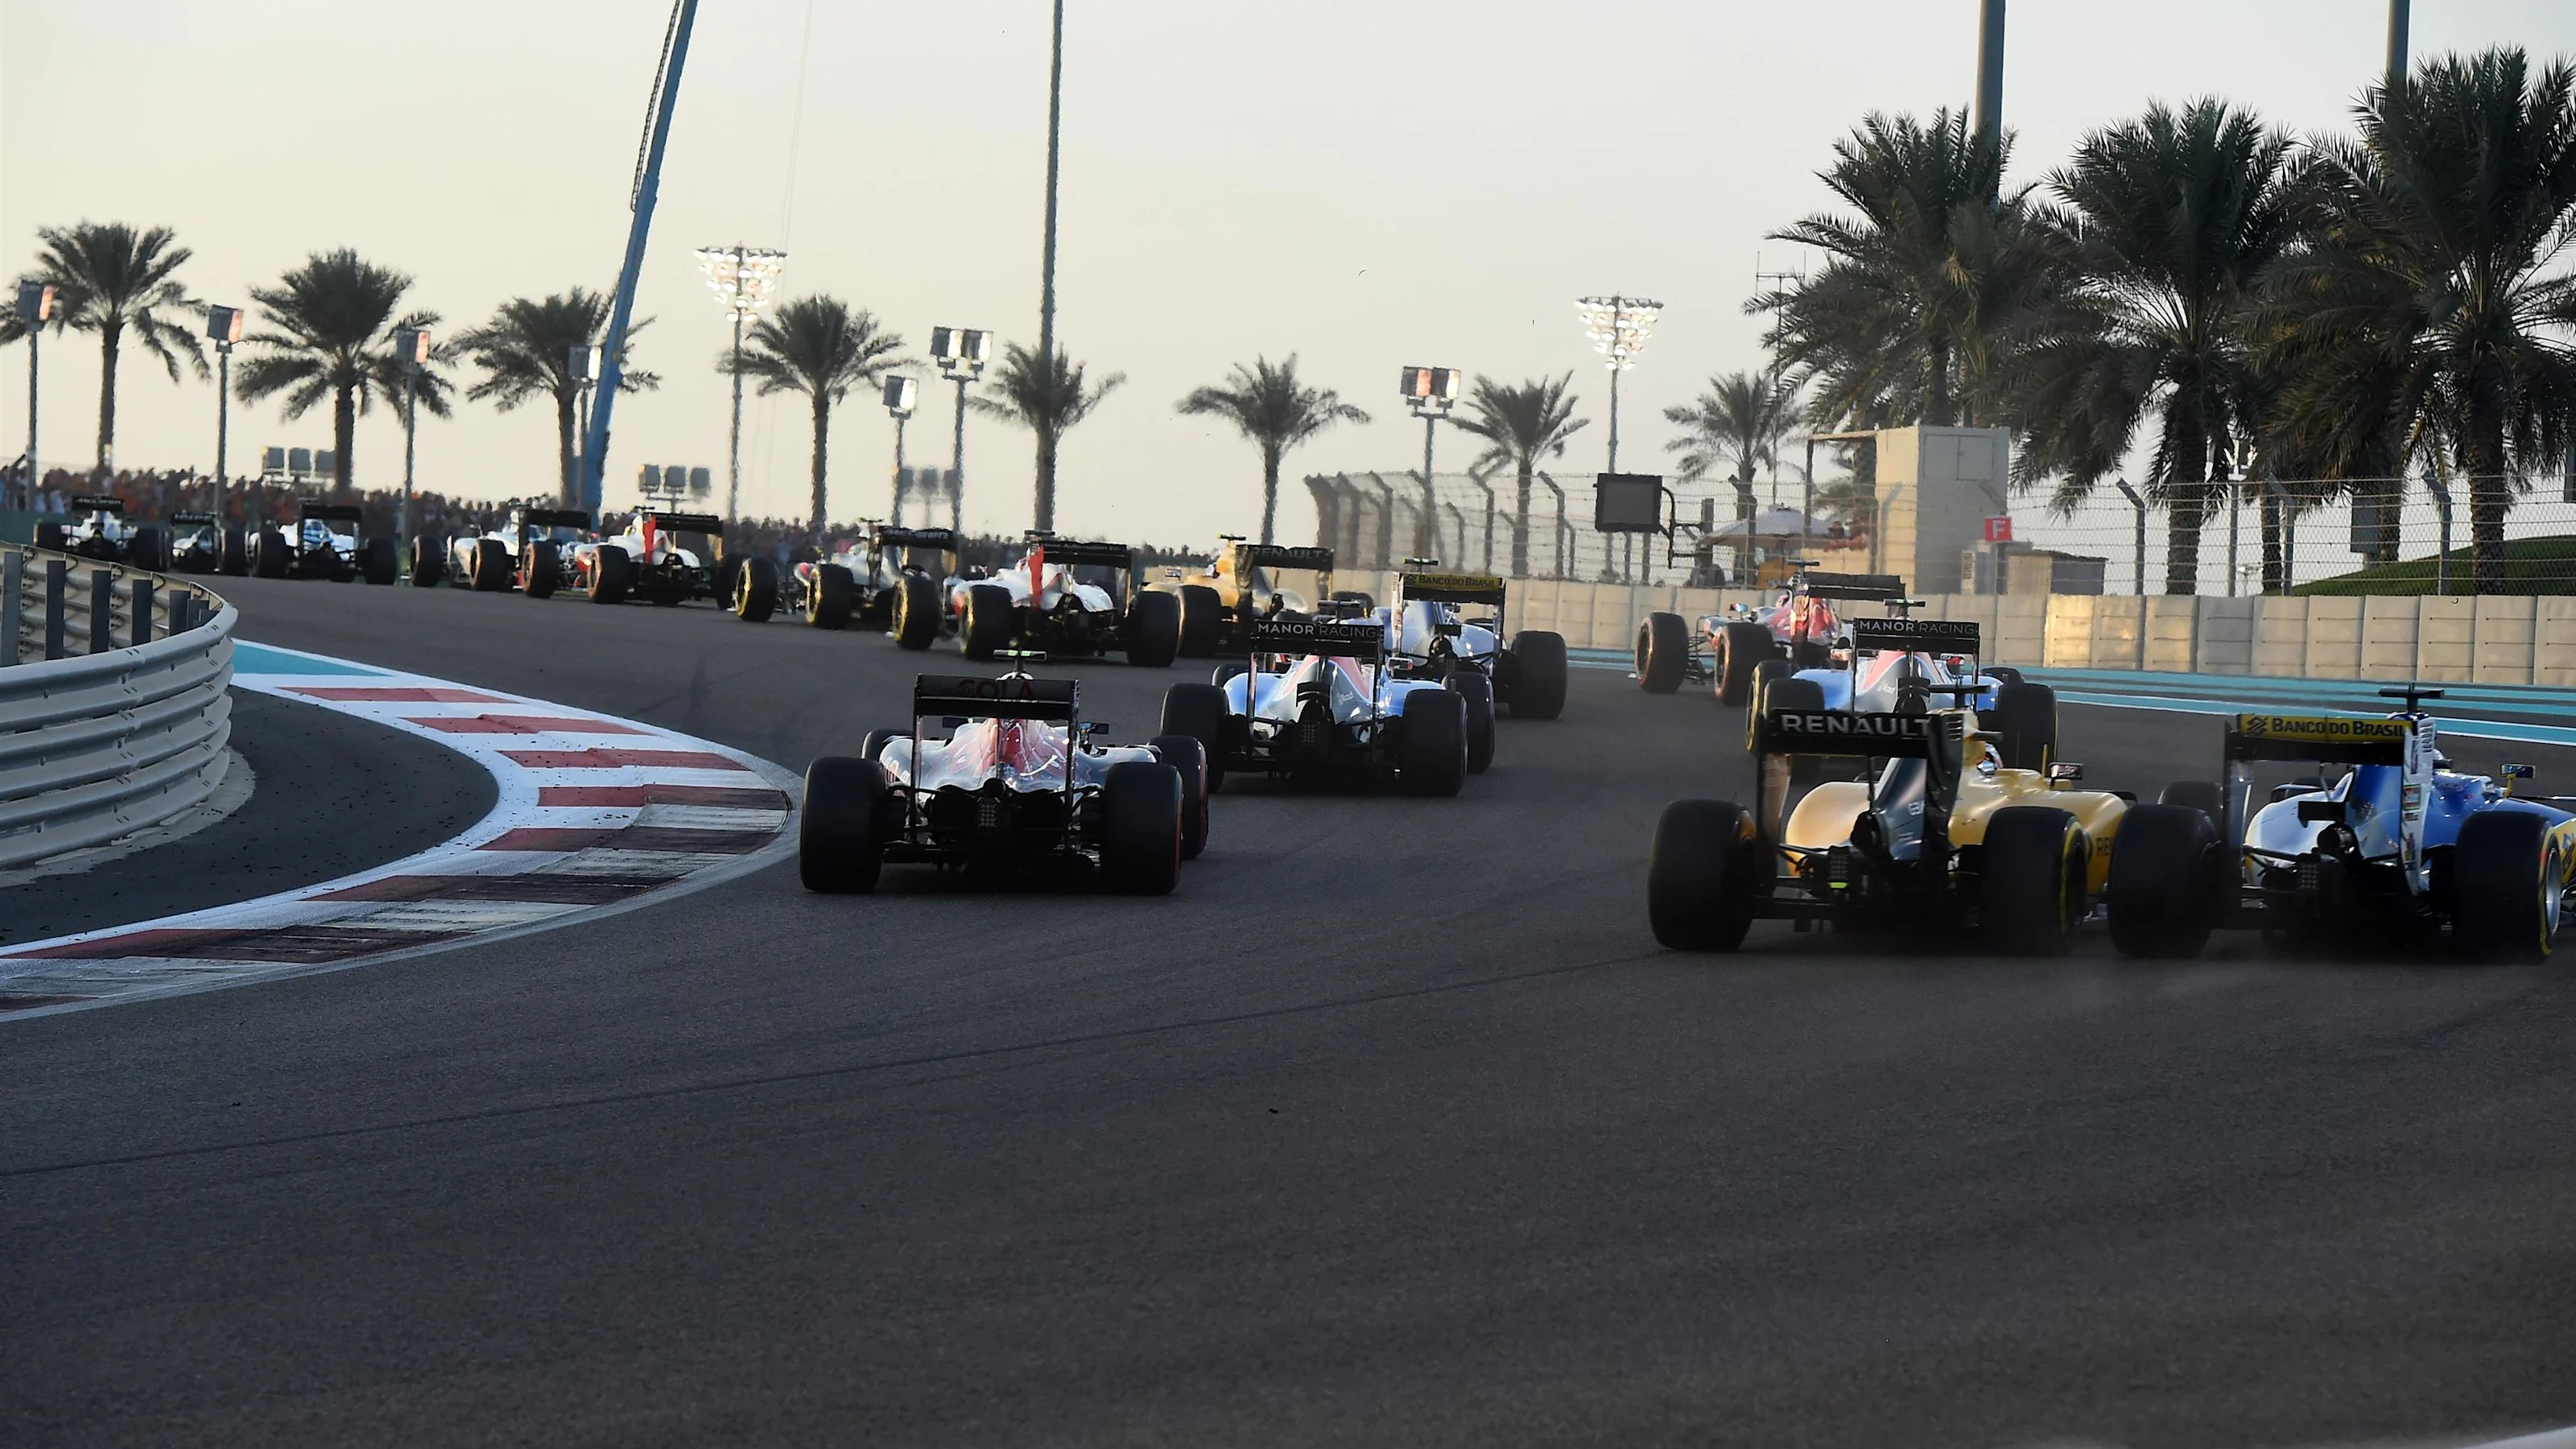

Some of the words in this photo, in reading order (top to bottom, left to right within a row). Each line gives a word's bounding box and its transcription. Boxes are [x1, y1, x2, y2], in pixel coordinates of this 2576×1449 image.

[1992, 520, 2005, 539] F
[1250, 547, 1323, 559] RENAULT
[1419, 575, 1450, 585] BANCO
[1452, 577, 1463, 586] DO
[1466, 576, 1496, 588] BRASIL
[1257, 623, 1314, 634] MANOR
[1319, 625, 1376, 638] RACING
[1860, 621, 1914, 632] MANOR
[1919, 623, 1974, 634] RACING
[1781, 714, 1930, 736] RENAULT
[2272, 717, 2325, 734] BANCO
[2330, 721, 2349, 735] DO
[2353, 720, 2405, 737] BRASIL
